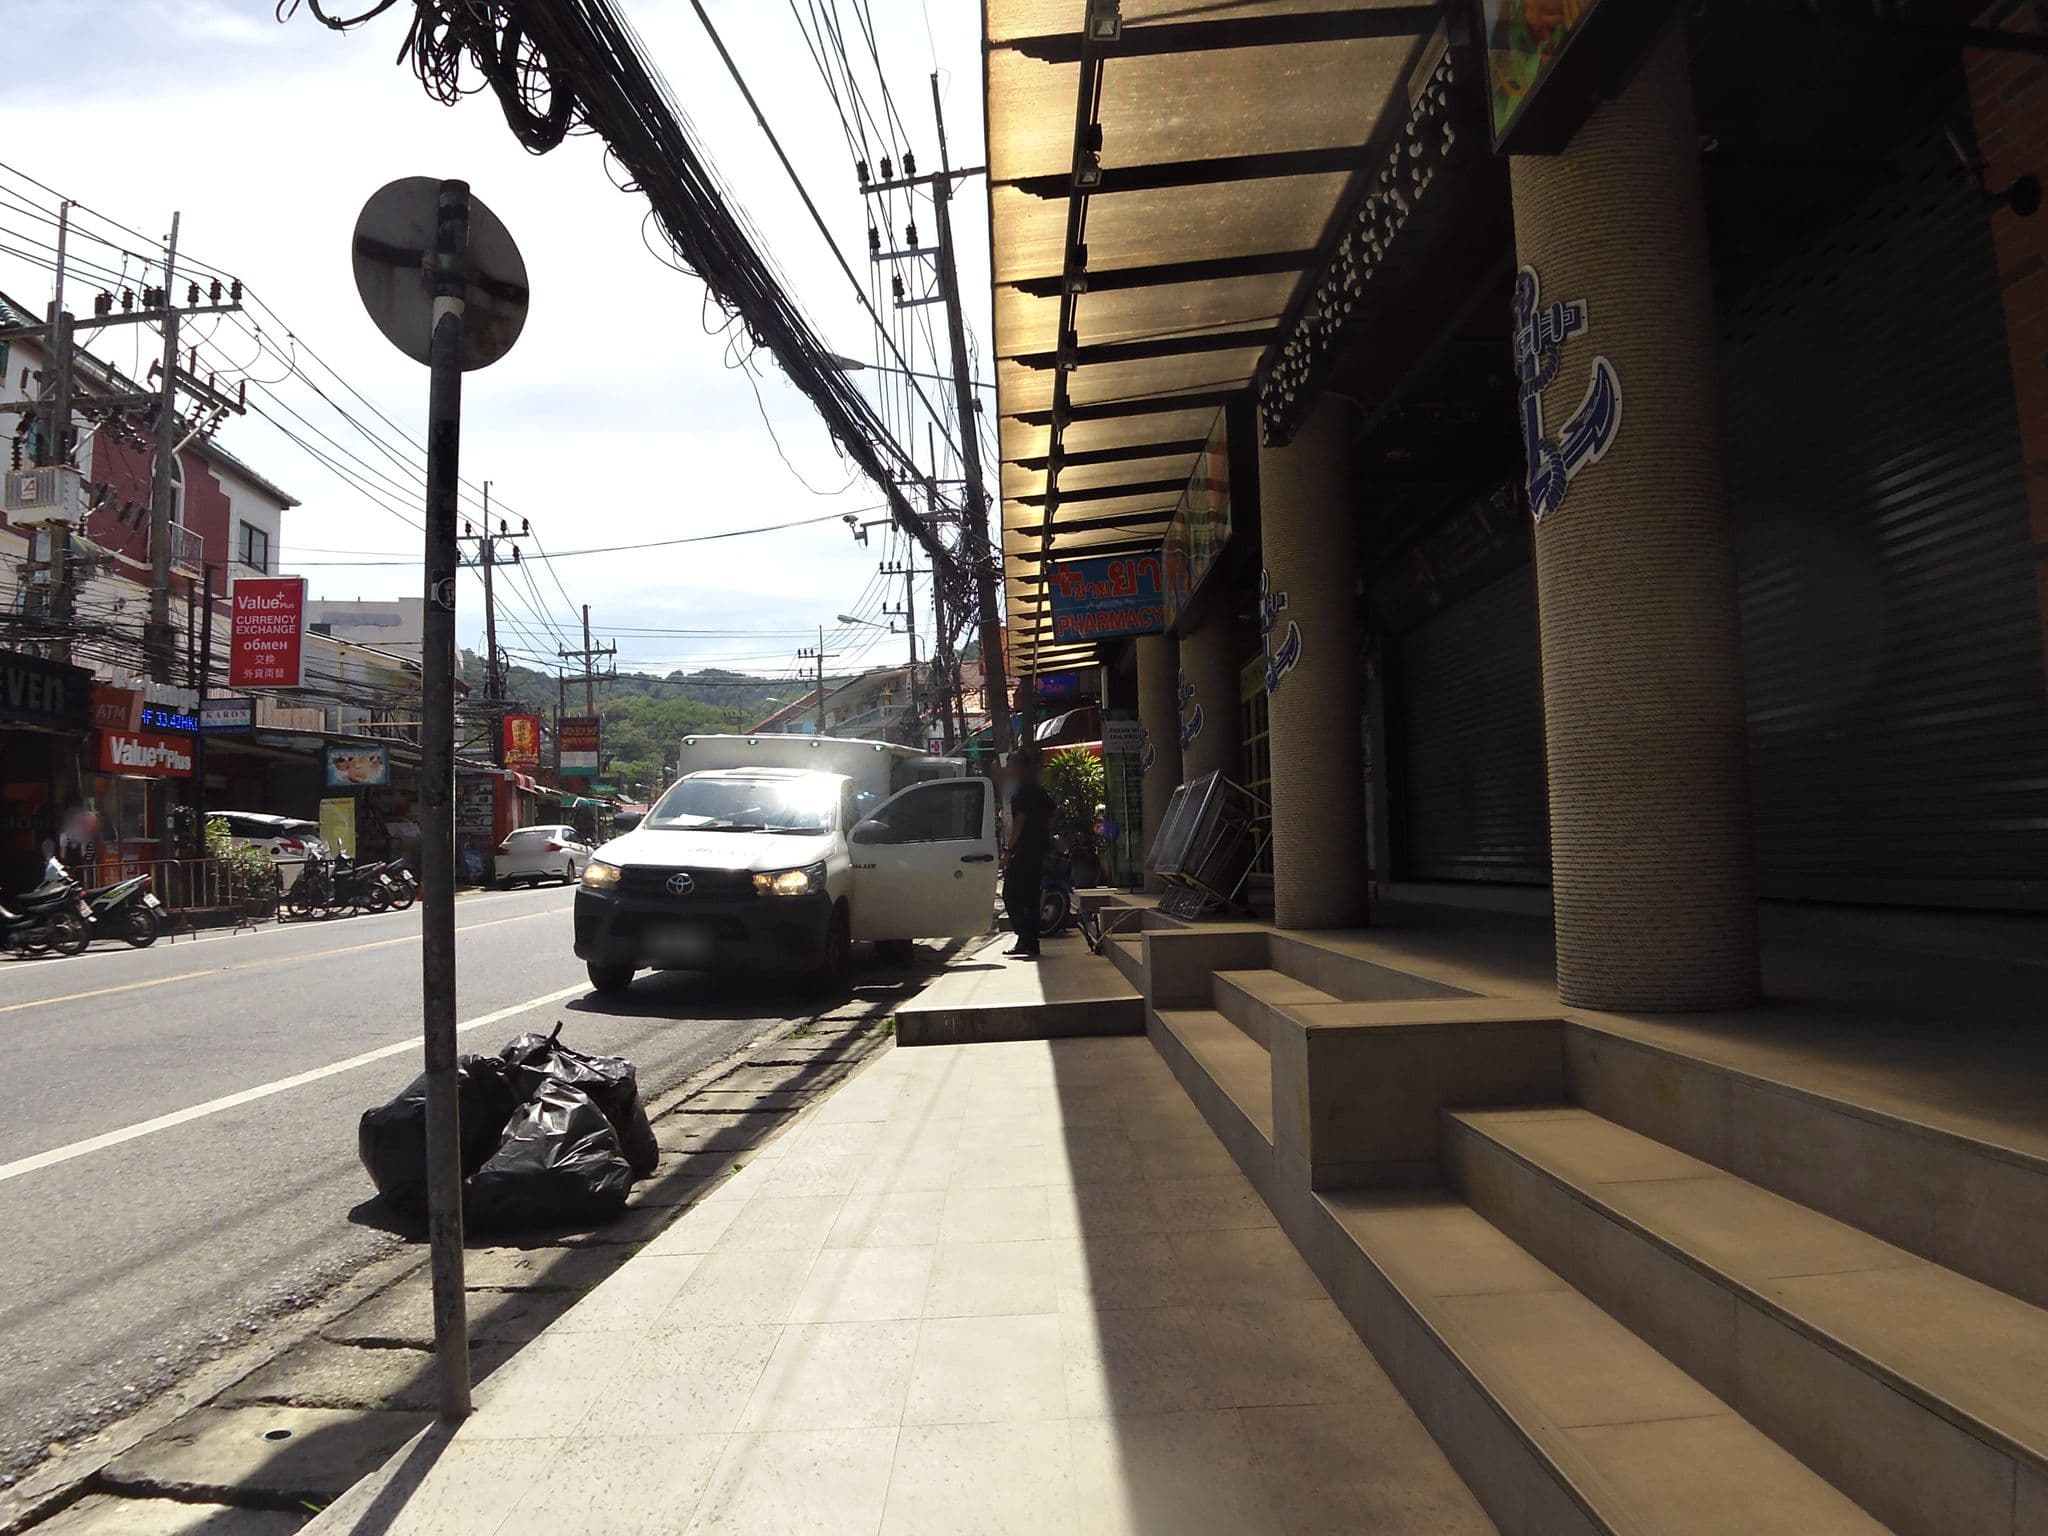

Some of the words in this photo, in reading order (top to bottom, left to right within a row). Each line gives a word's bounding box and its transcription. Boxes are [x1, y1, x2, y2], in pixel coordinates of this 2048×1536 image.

[236, 615, 296, 625] CURRENCY
[1057, 606, 1164, 637] PHARMACY
[236, 625, 296, 635] EXCHANGE
[243, 639, 288, 651] обмен
[96, 704, 126, 721] ATM
[206, 711, 247, 719] KARON
